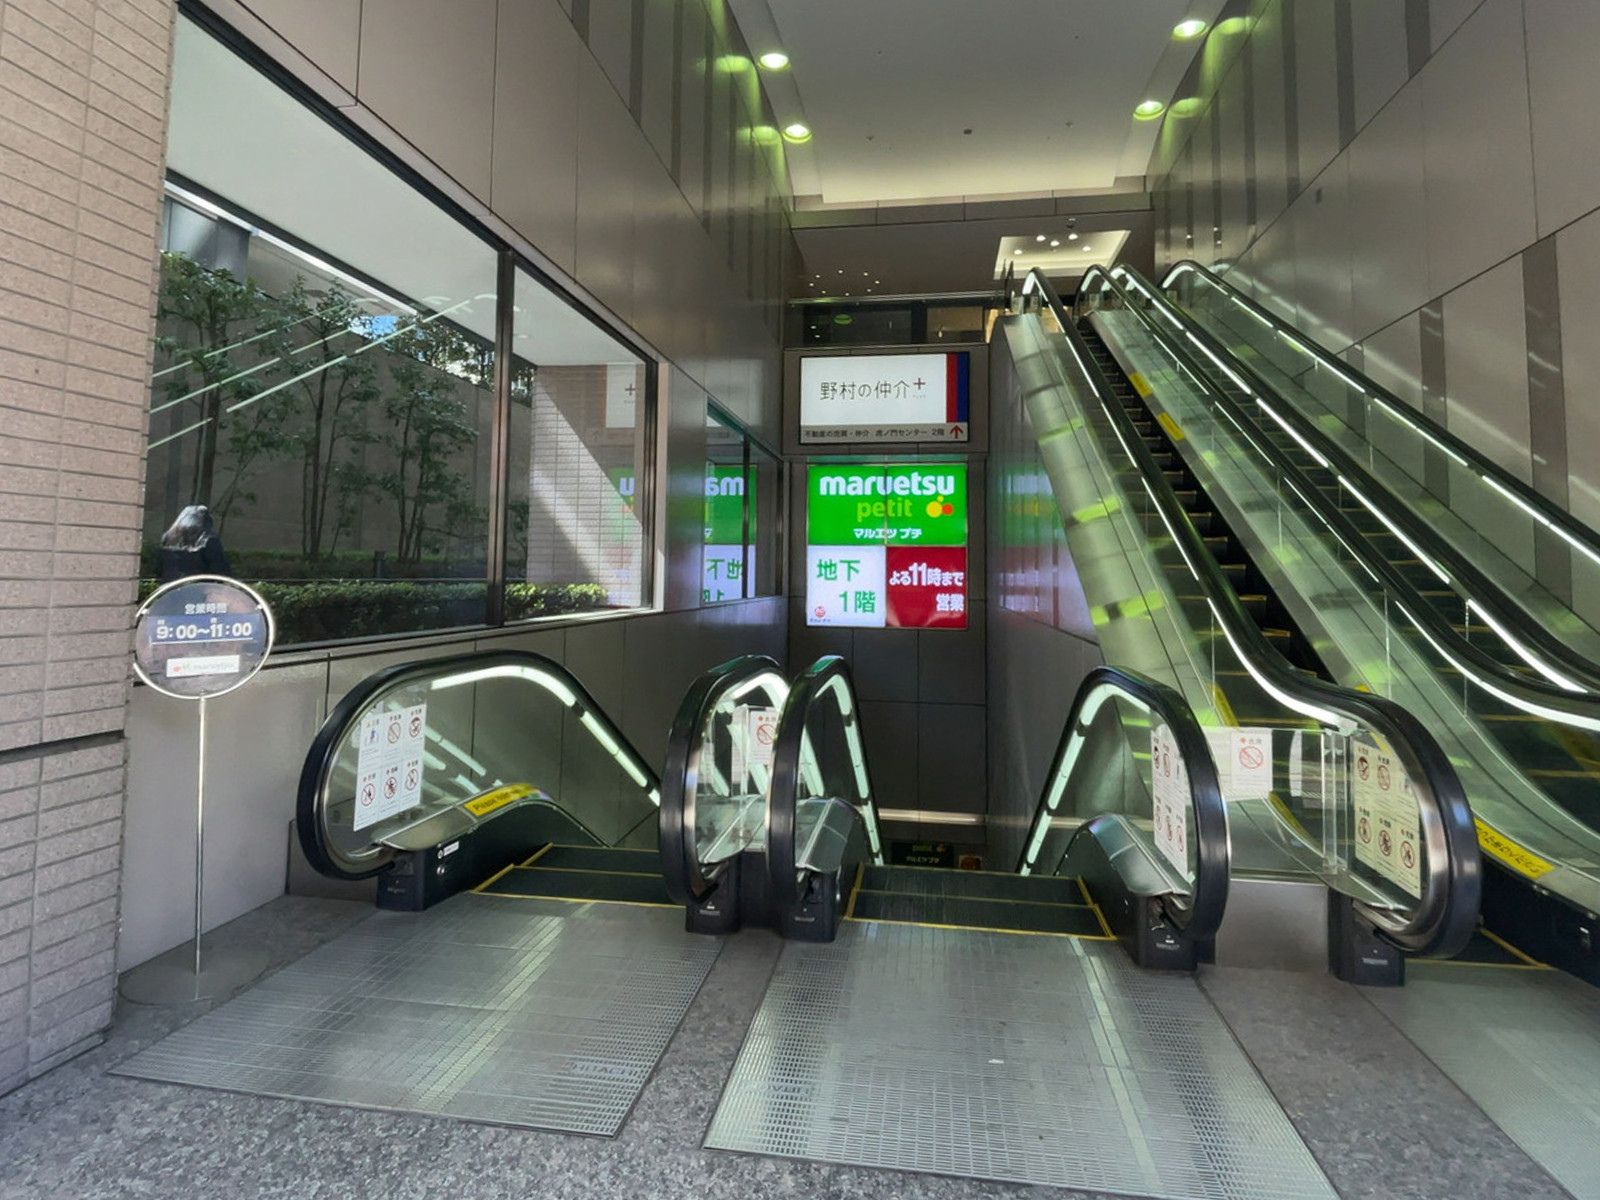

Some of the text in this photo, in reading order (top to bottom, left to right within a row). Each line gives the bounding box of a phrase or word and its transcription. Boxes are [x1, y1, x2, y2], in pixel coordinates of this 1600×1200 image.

[819, 471, 955, 496] maruetsu
[856, 498, 912, 523] petit
[816, 558, 861, 582] 地下
[889, 562, 964, 587] よる11時まで
[184, 603, 227, 615] 営業時間
[839, 590, 876, 614] 1階
[936, 593, 965, 612] 営業
